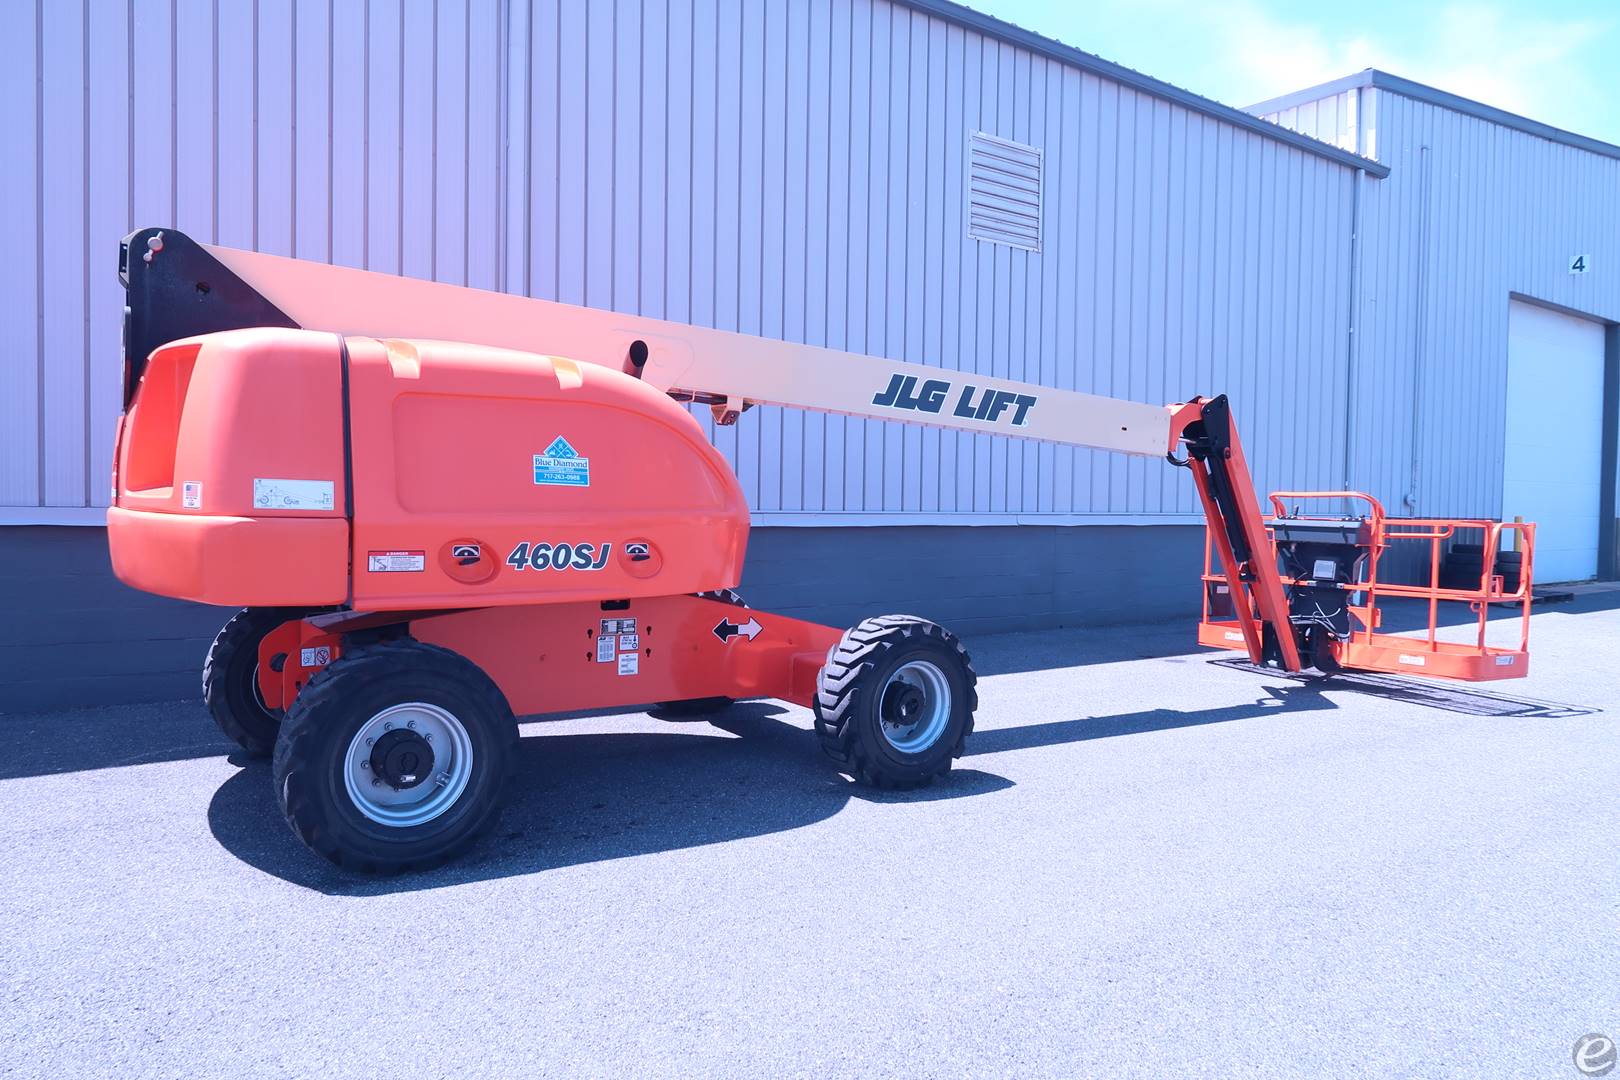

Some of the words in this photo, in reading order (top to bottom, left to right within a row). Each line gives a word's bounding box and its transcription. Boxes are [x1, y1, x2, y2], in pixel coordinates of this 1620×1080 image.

[1571, 255, 1586, 272] 4
[871, 372, 952, 415] JLG
[952, 384, 1038, 426] LIFT
[535, 457, 552, 466] Blue
[553, 459, 588, 468] Diamond
[506, 542, 612, 571] 460SJ
